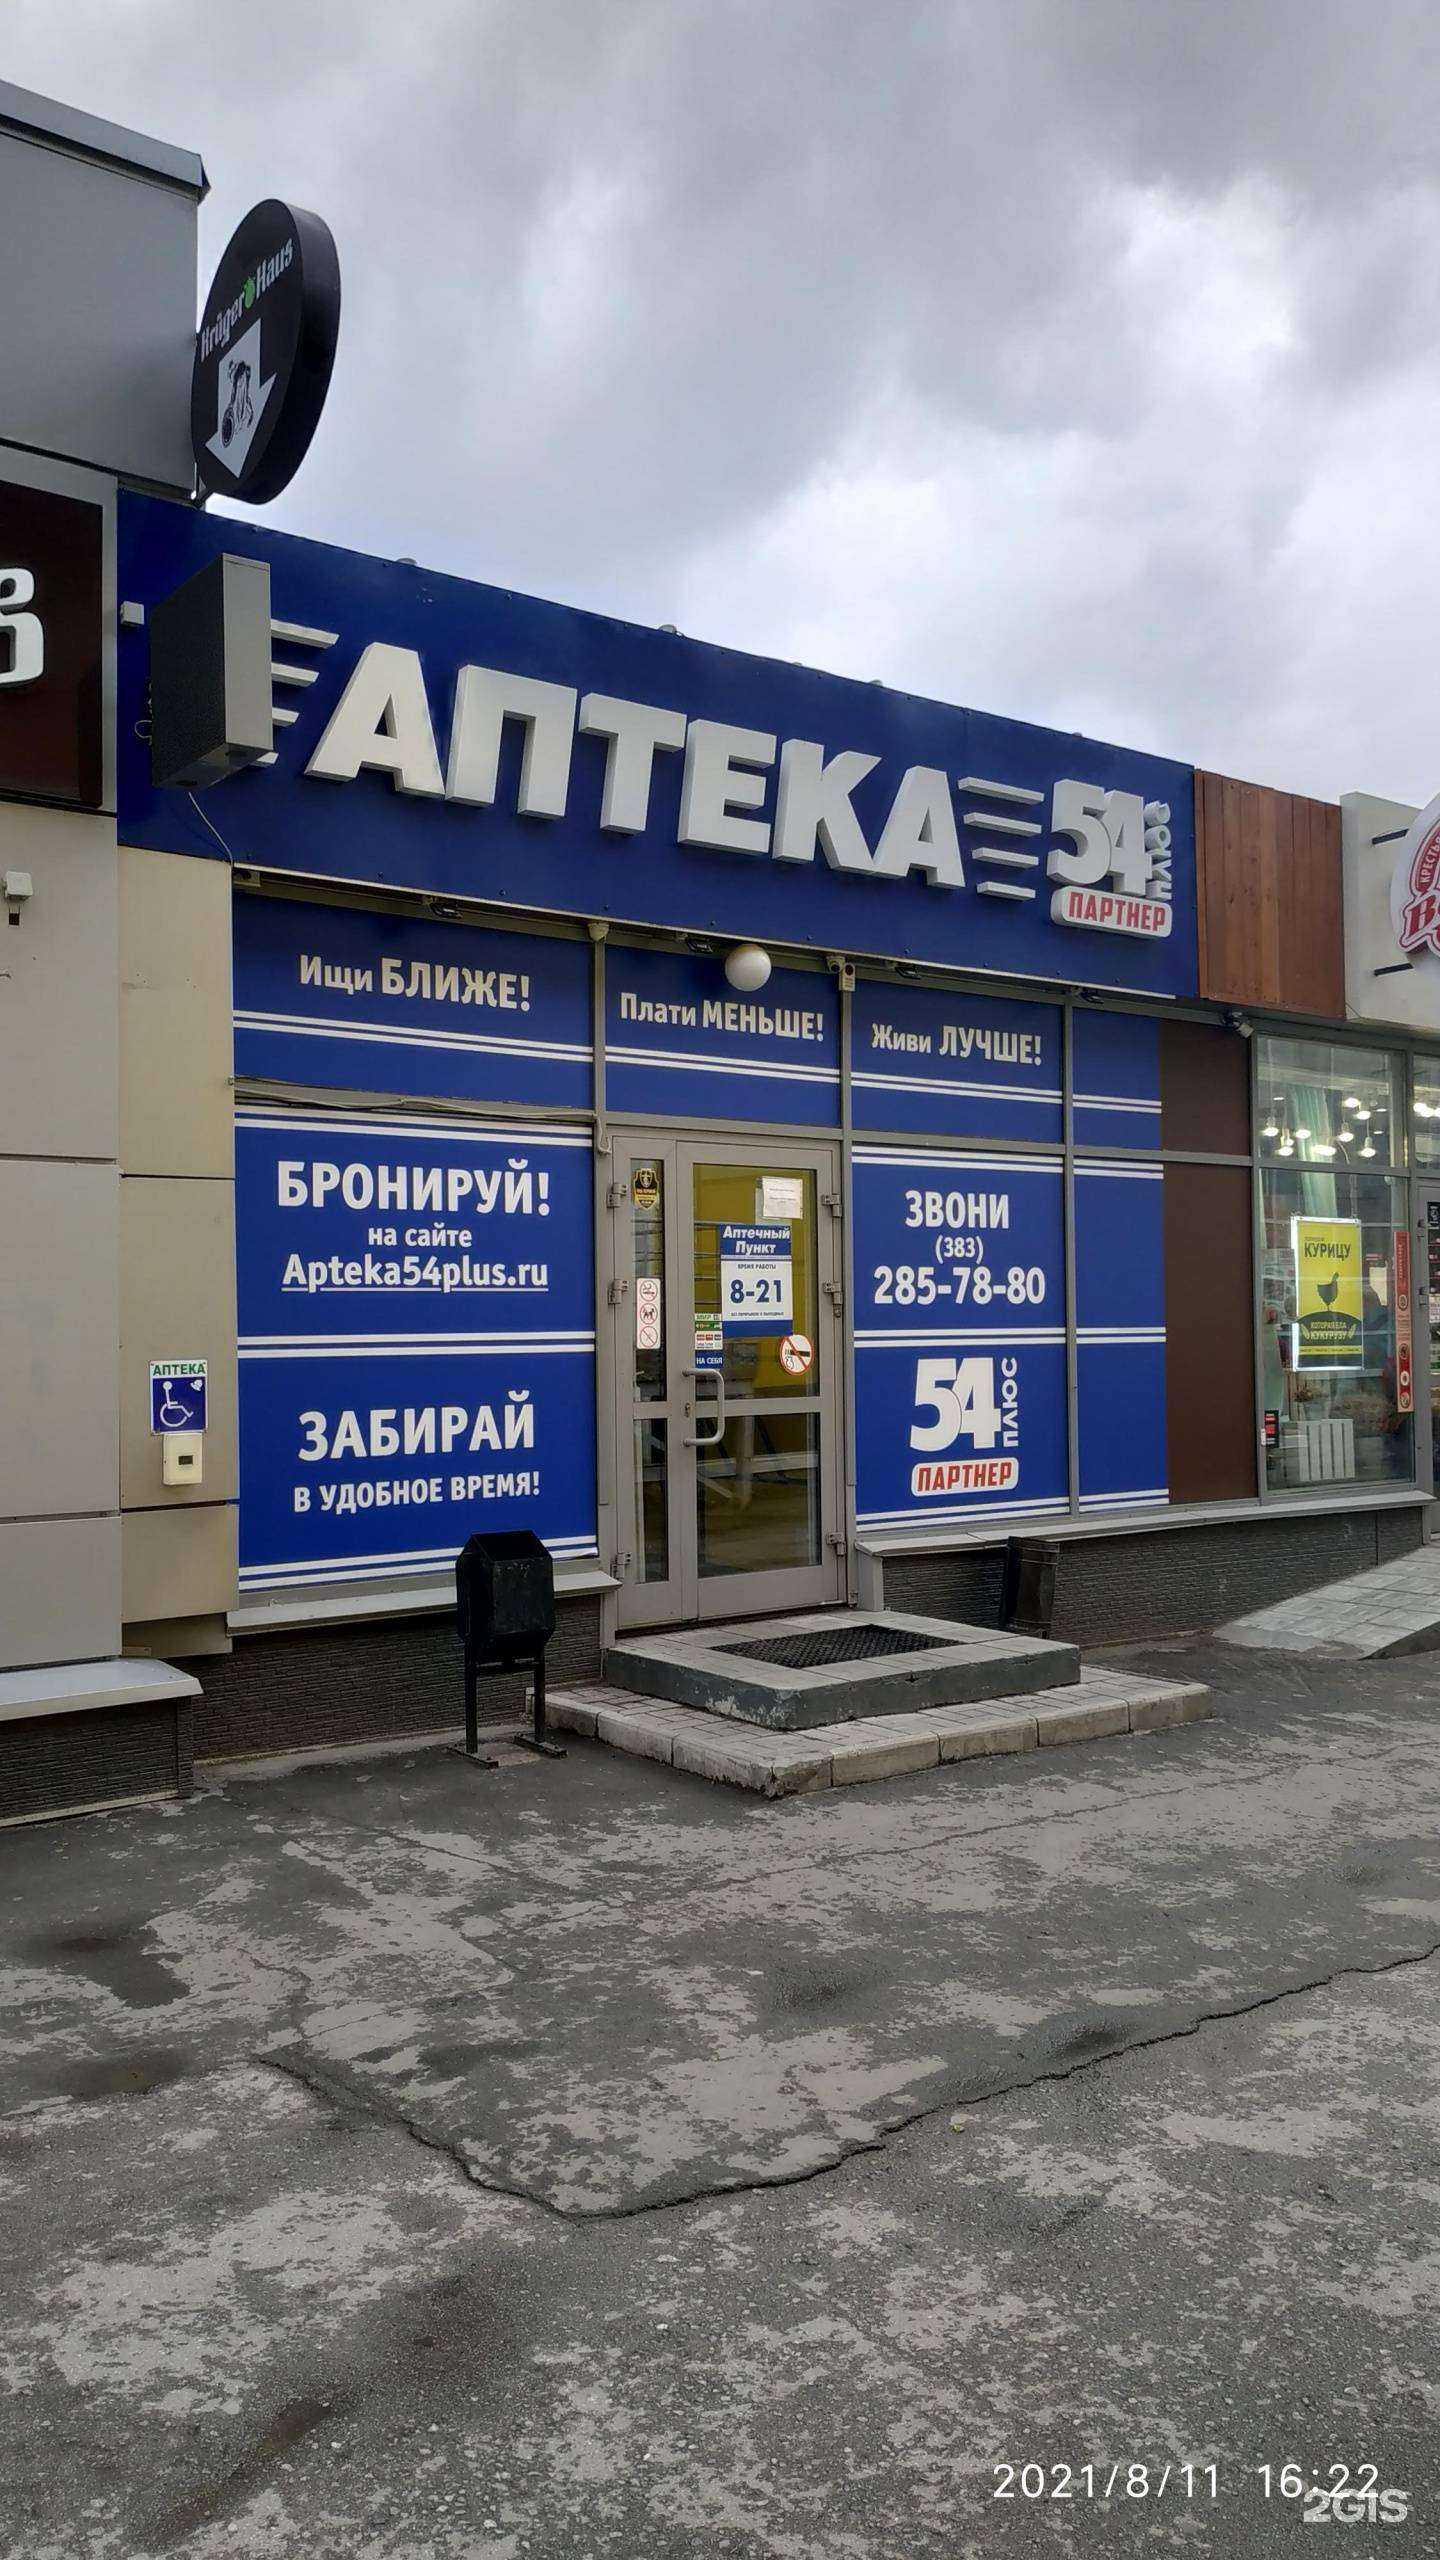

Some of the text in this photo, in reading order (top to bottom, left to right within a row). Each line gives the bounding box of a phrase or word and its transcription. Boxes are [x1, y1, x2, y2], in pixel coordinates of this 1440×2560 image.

[255, 238, 294, 300] Haus
[304, 641, 965, 888] АПТЕКА
[1047, 779, 1146, 896] 54
[1144, 800, 1173, 900] ПЛЮС
[1068, 891, 1166, 932] ПАРТНЕР
[299, 954, 531, 1012] Ищи БЛИЖЕ!
[619, 992, 825, 1042] Плати МЕНЬШЕ!
[870, 1023, 1042, 1066] Живи ЛУЧШЕ!
[277, 1157, 551, 1217] БРОНИРУЙ!
[905, 1190, 1010, 1229] ЗВОНИ
[368, 1222, 473, 1248] на сайте
[722, 1225, 791, 1240] Аптечный
[735, 1240, 777, 1256] Пункт
[934, 1235, 984, 1265] (383)
[1304, 1242, 1351, 1261] КУРИЦУ
[281, 1253, 549, 1293] Apteka54plus.ru
[730, 1279, 782, 1304] 8-21
[873, 1265, 1046, 1306] 285-78-80
[910, 1356, 1002, 1452] 54
[1002, 1357, 1019, 1448] ПЛЮС
[298, 1389, 535, 1461] ЗАБИРАЙ
[319, 1476, 444, 1515] УДОБНОЕ
[450, 1470, 541, 1502] ВРЕМЯ!
[915, 1461, 1013, 1492] ПАРТНЕР
